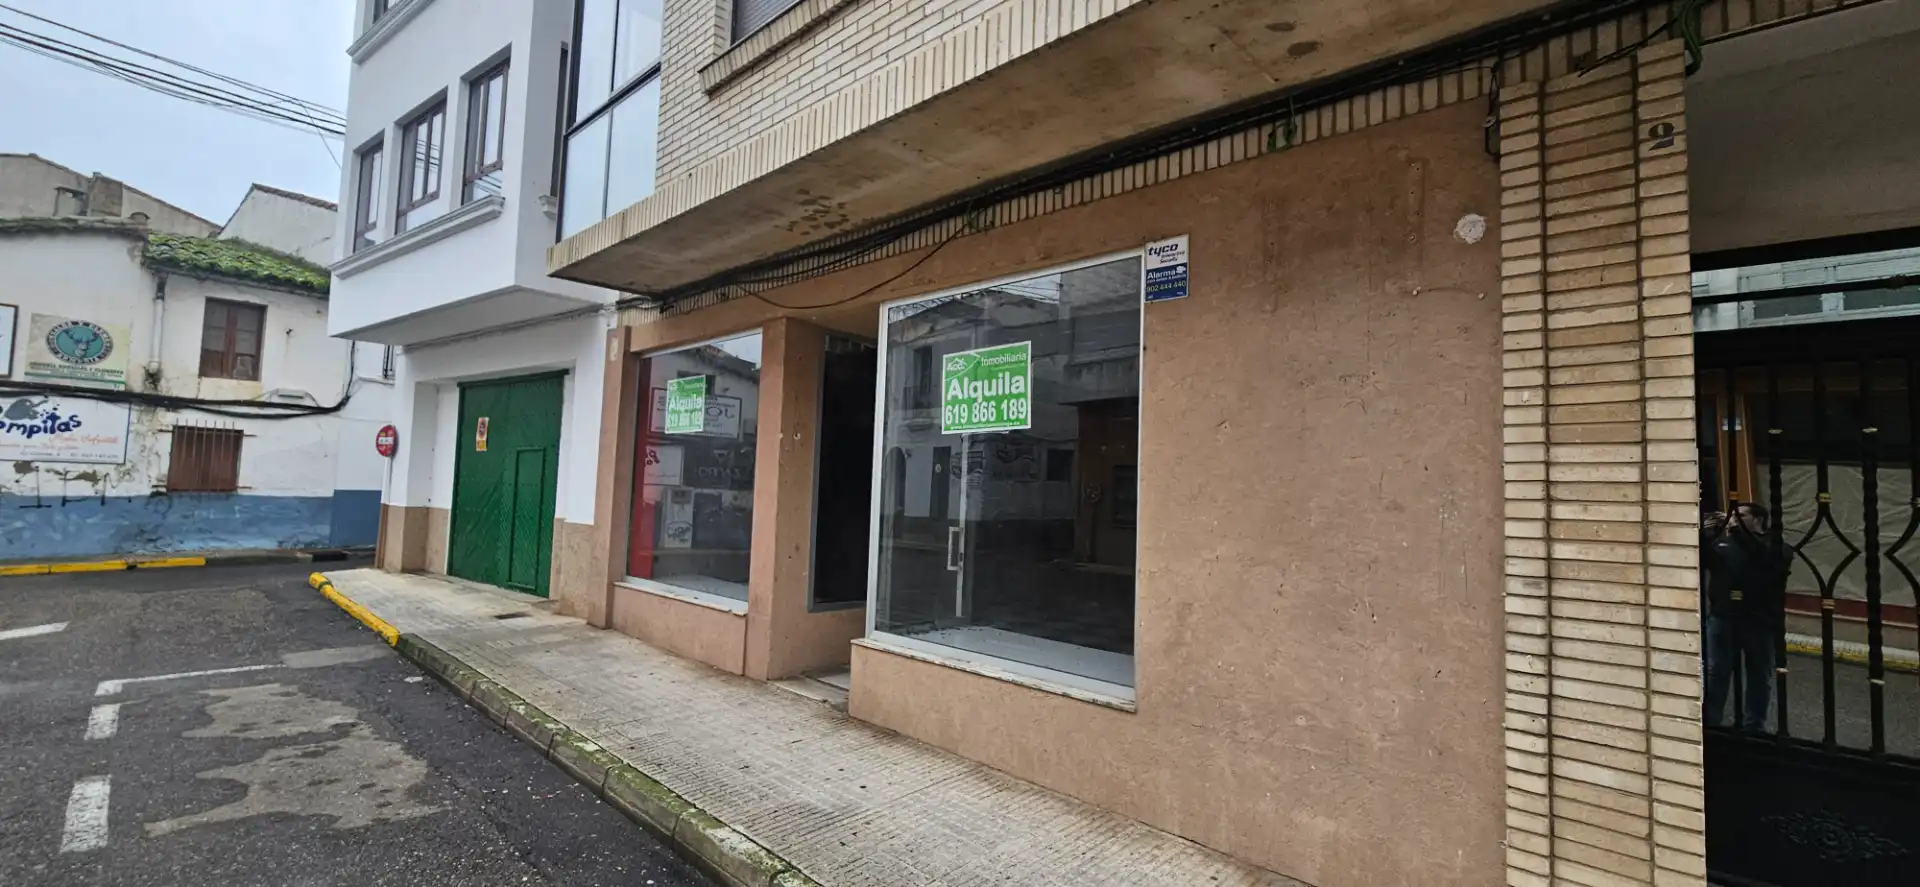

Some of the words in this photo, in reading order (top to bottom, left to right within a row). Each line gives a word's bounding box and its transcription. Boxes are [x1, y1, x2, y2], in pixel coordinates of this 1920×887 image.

[1648, 122, 1675, 151] 2
[1148, 244, 1178, 256] tyco
[1147, 270, 1176, 280] Alarma
[1160, 282, 1172, 290] 444
[1173, 280, 1186, 288] 440
[981, 352, 1027, 367] Inmobiliaria
[947, 371, 1025, 403] Alquila
[669, 394, 702, 413] Alquila
[945, 404, 968, 425] 619
[972, 400, 997, 423] 866
[1001, 398, 1027, 421] 189
